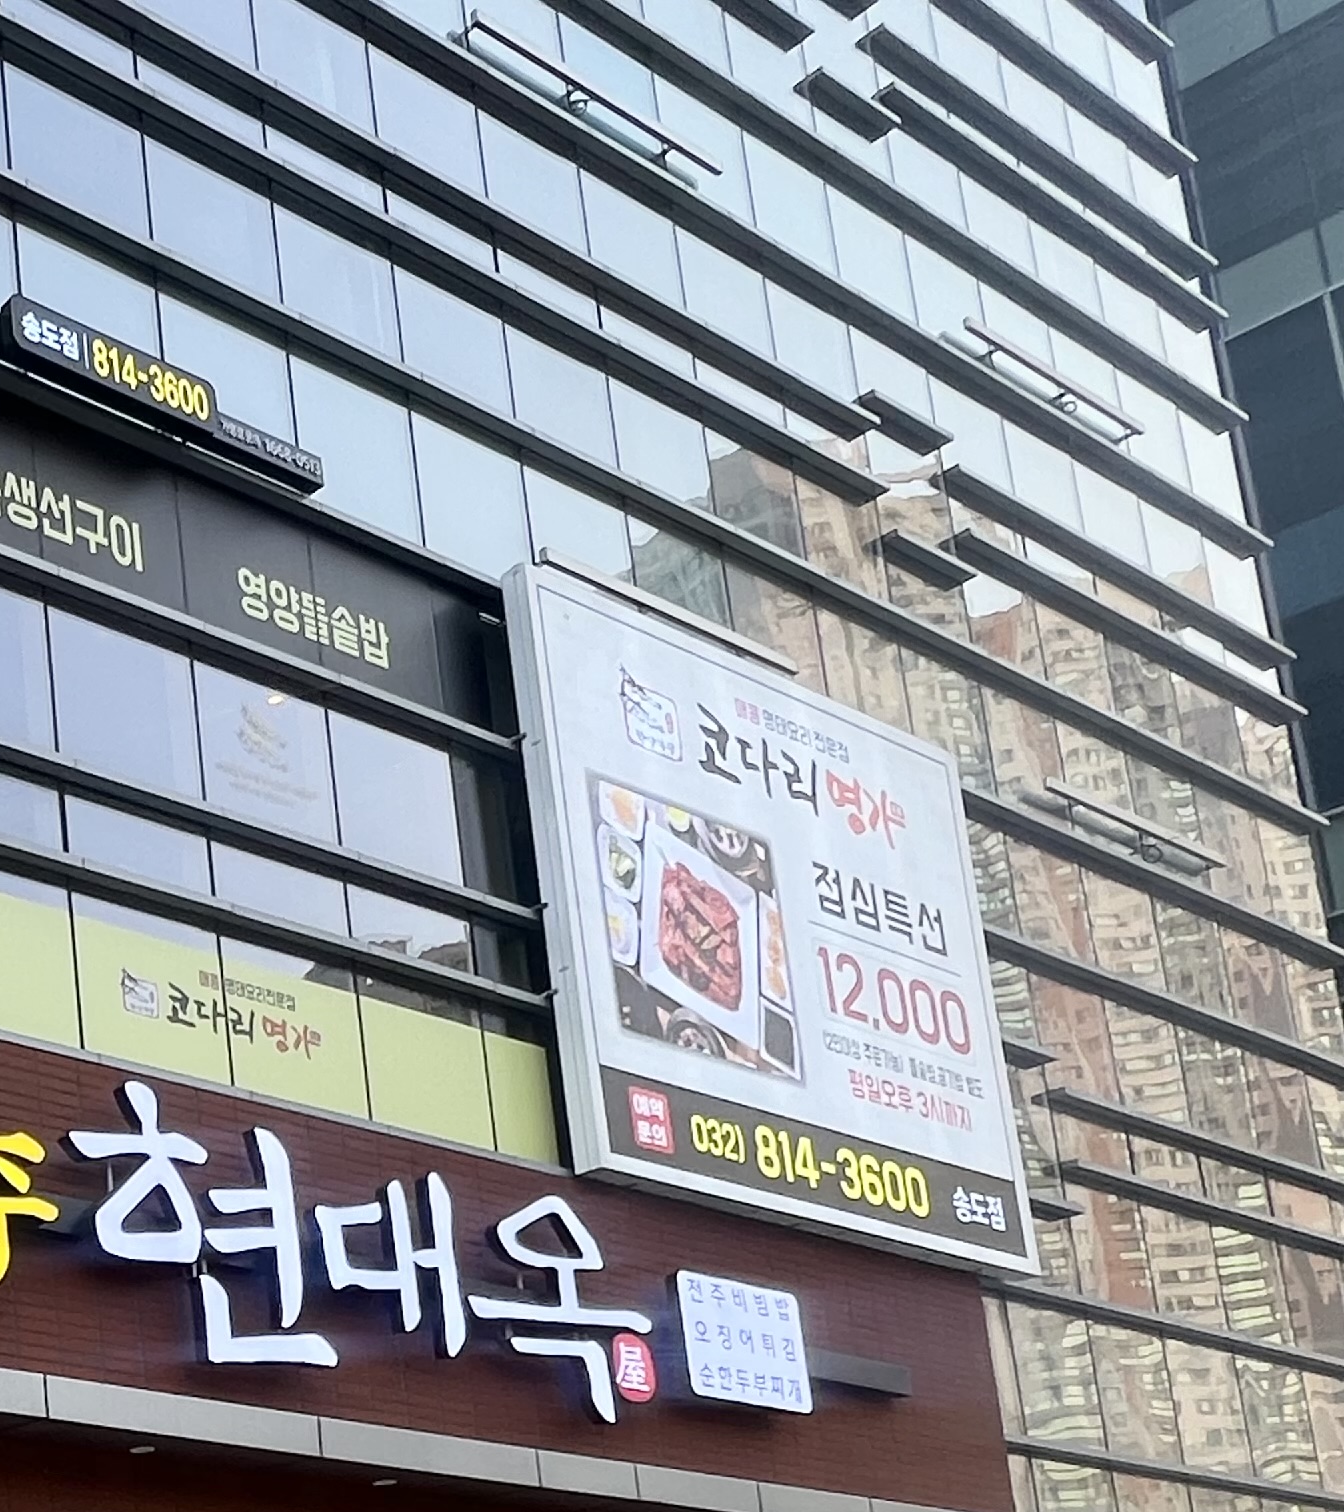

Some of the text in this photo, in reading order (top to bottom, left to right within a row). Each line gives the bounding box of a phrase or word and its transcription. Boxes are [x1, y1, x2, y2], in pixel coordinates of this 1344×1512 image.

[20, 310, 210, 422] 송도점 814-3600
[697, 702, 906, 850] 코다리 명가
[812, 860, 948, 958] 점심특선
[167, 982, 321, 1060] 코다리 명가
[690, 1113, 1006, 1233] 032) 814-3600 송도점
[68, 1080, 653, 1425] 현대옥
[694, 1320, 797, 1362] 오징어튀김
